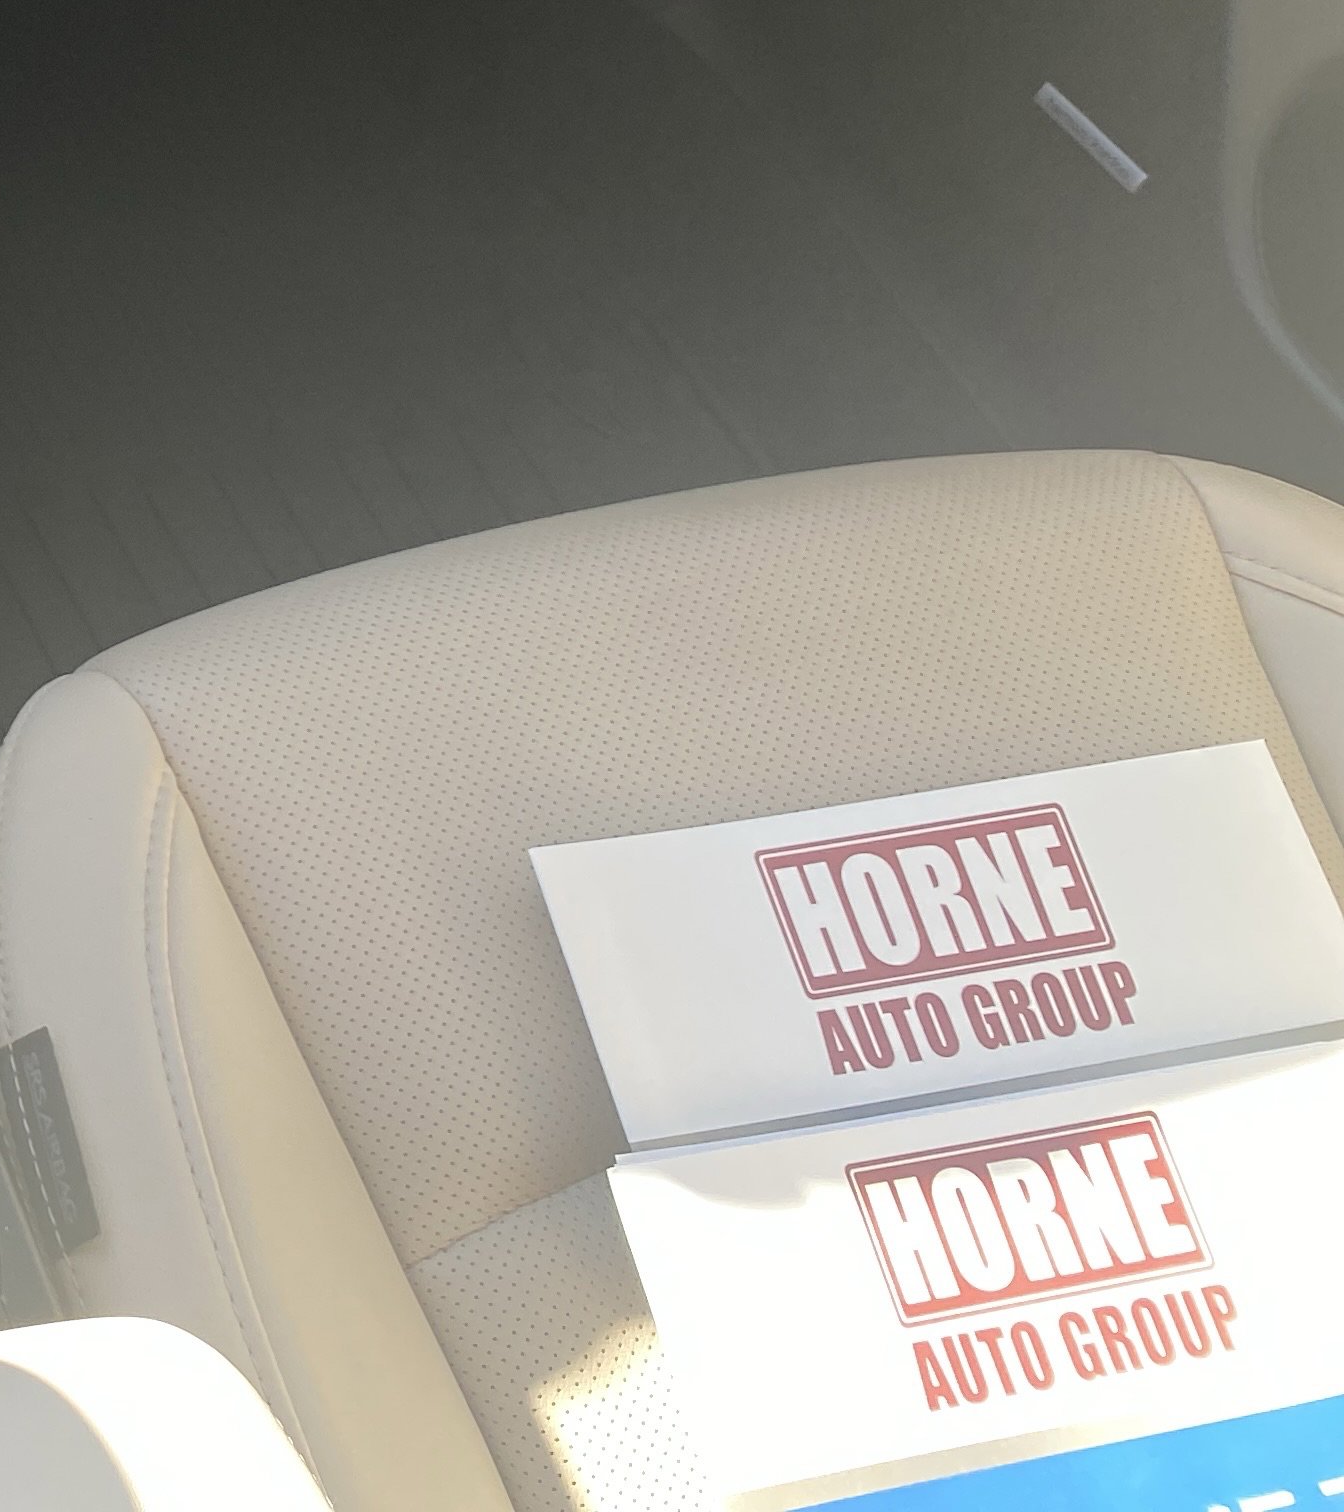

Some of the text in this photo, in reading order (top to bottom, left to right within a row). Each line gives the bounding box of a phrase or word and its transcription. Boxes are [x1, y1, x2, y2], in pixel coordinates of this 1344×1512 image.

[773, 824, 1096, 978] HORNE
[816, 961, 1137, 1075] AUTO GROUP
[864, 1133, 1197, 1305] HORNE
[912, 1284, 1238, 1412] AUTO GROUP
